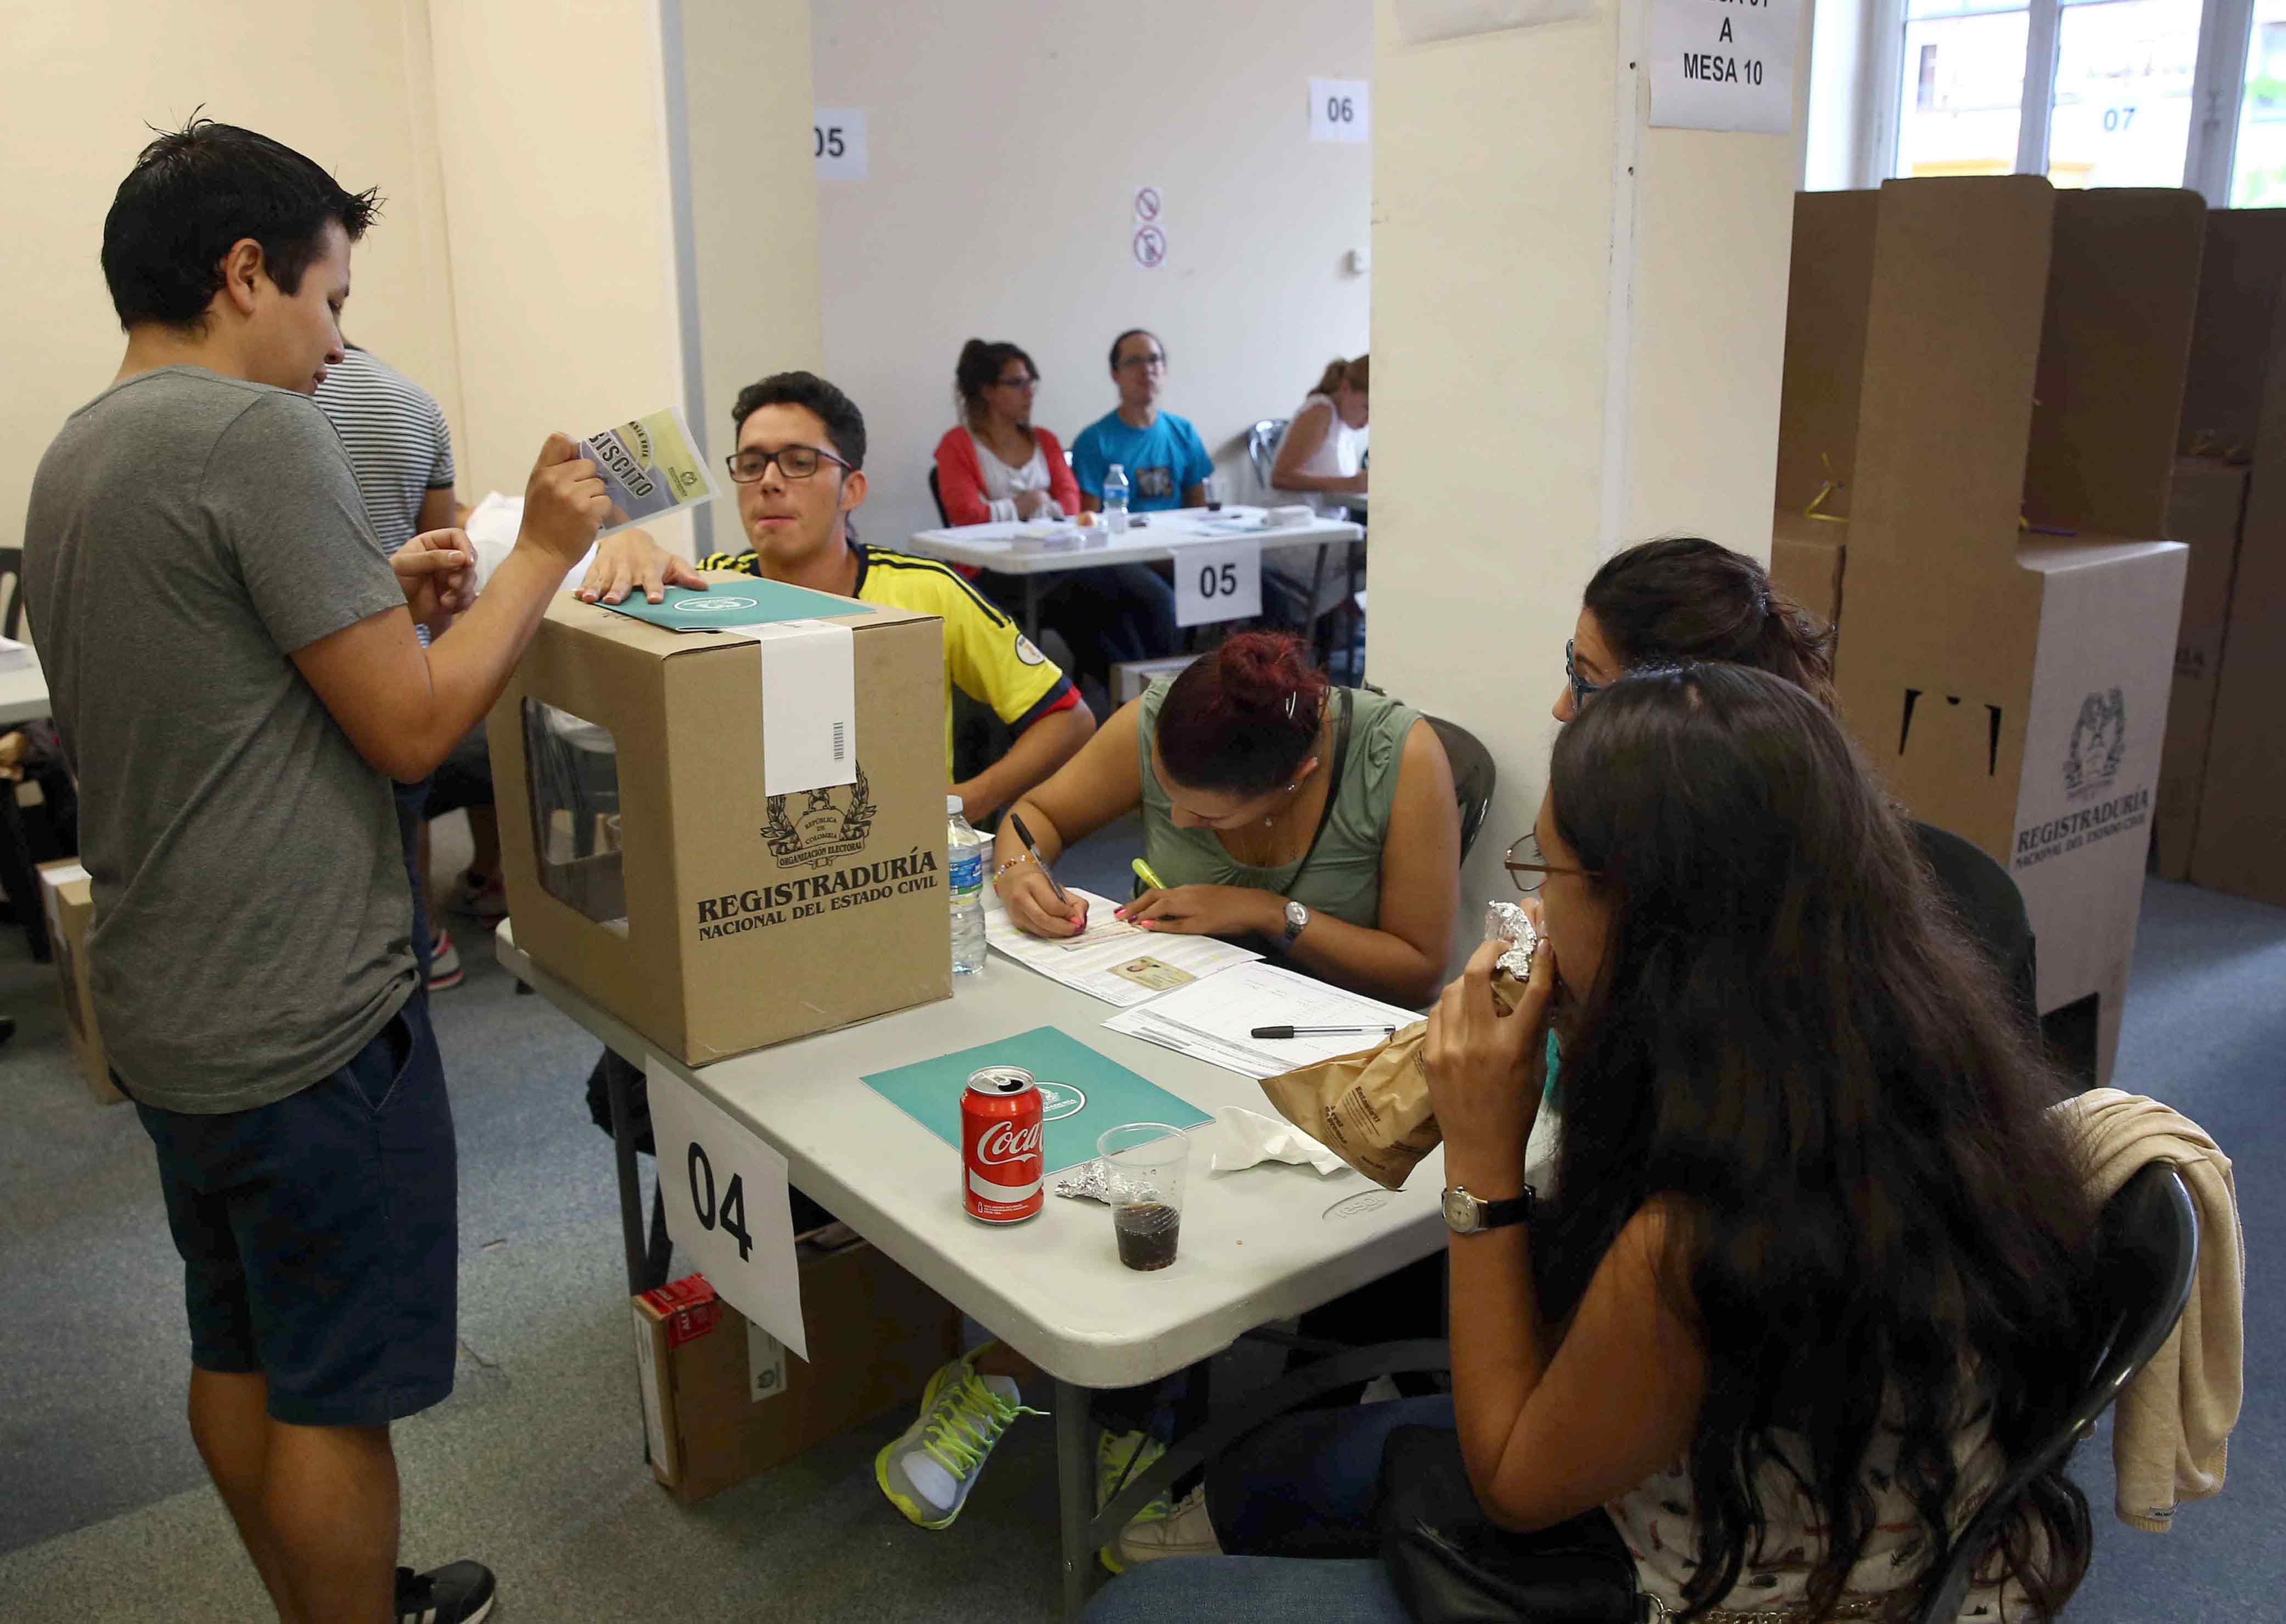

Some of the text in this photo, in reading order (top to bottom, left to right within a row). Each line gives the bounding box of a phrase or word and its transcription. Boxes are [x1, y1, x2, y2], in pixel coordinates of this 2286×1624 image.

[1719, 16, 1733, 43] A
[1683, 53, 1762, 85] MESA 10
[1327, 97, 1353, 123] 06
[2103, 107, 2136, 132] 07
[1200, 563, 1237, 599] 05
[828, 841, 862, 855] ELECTORAL
[697, 846, 938, 924] REGISTRADURÍA
[698, 875, 938, 941] NACIONAL DEL ESTADO CIVIL
[688, 1142, 753, 1263] 04
